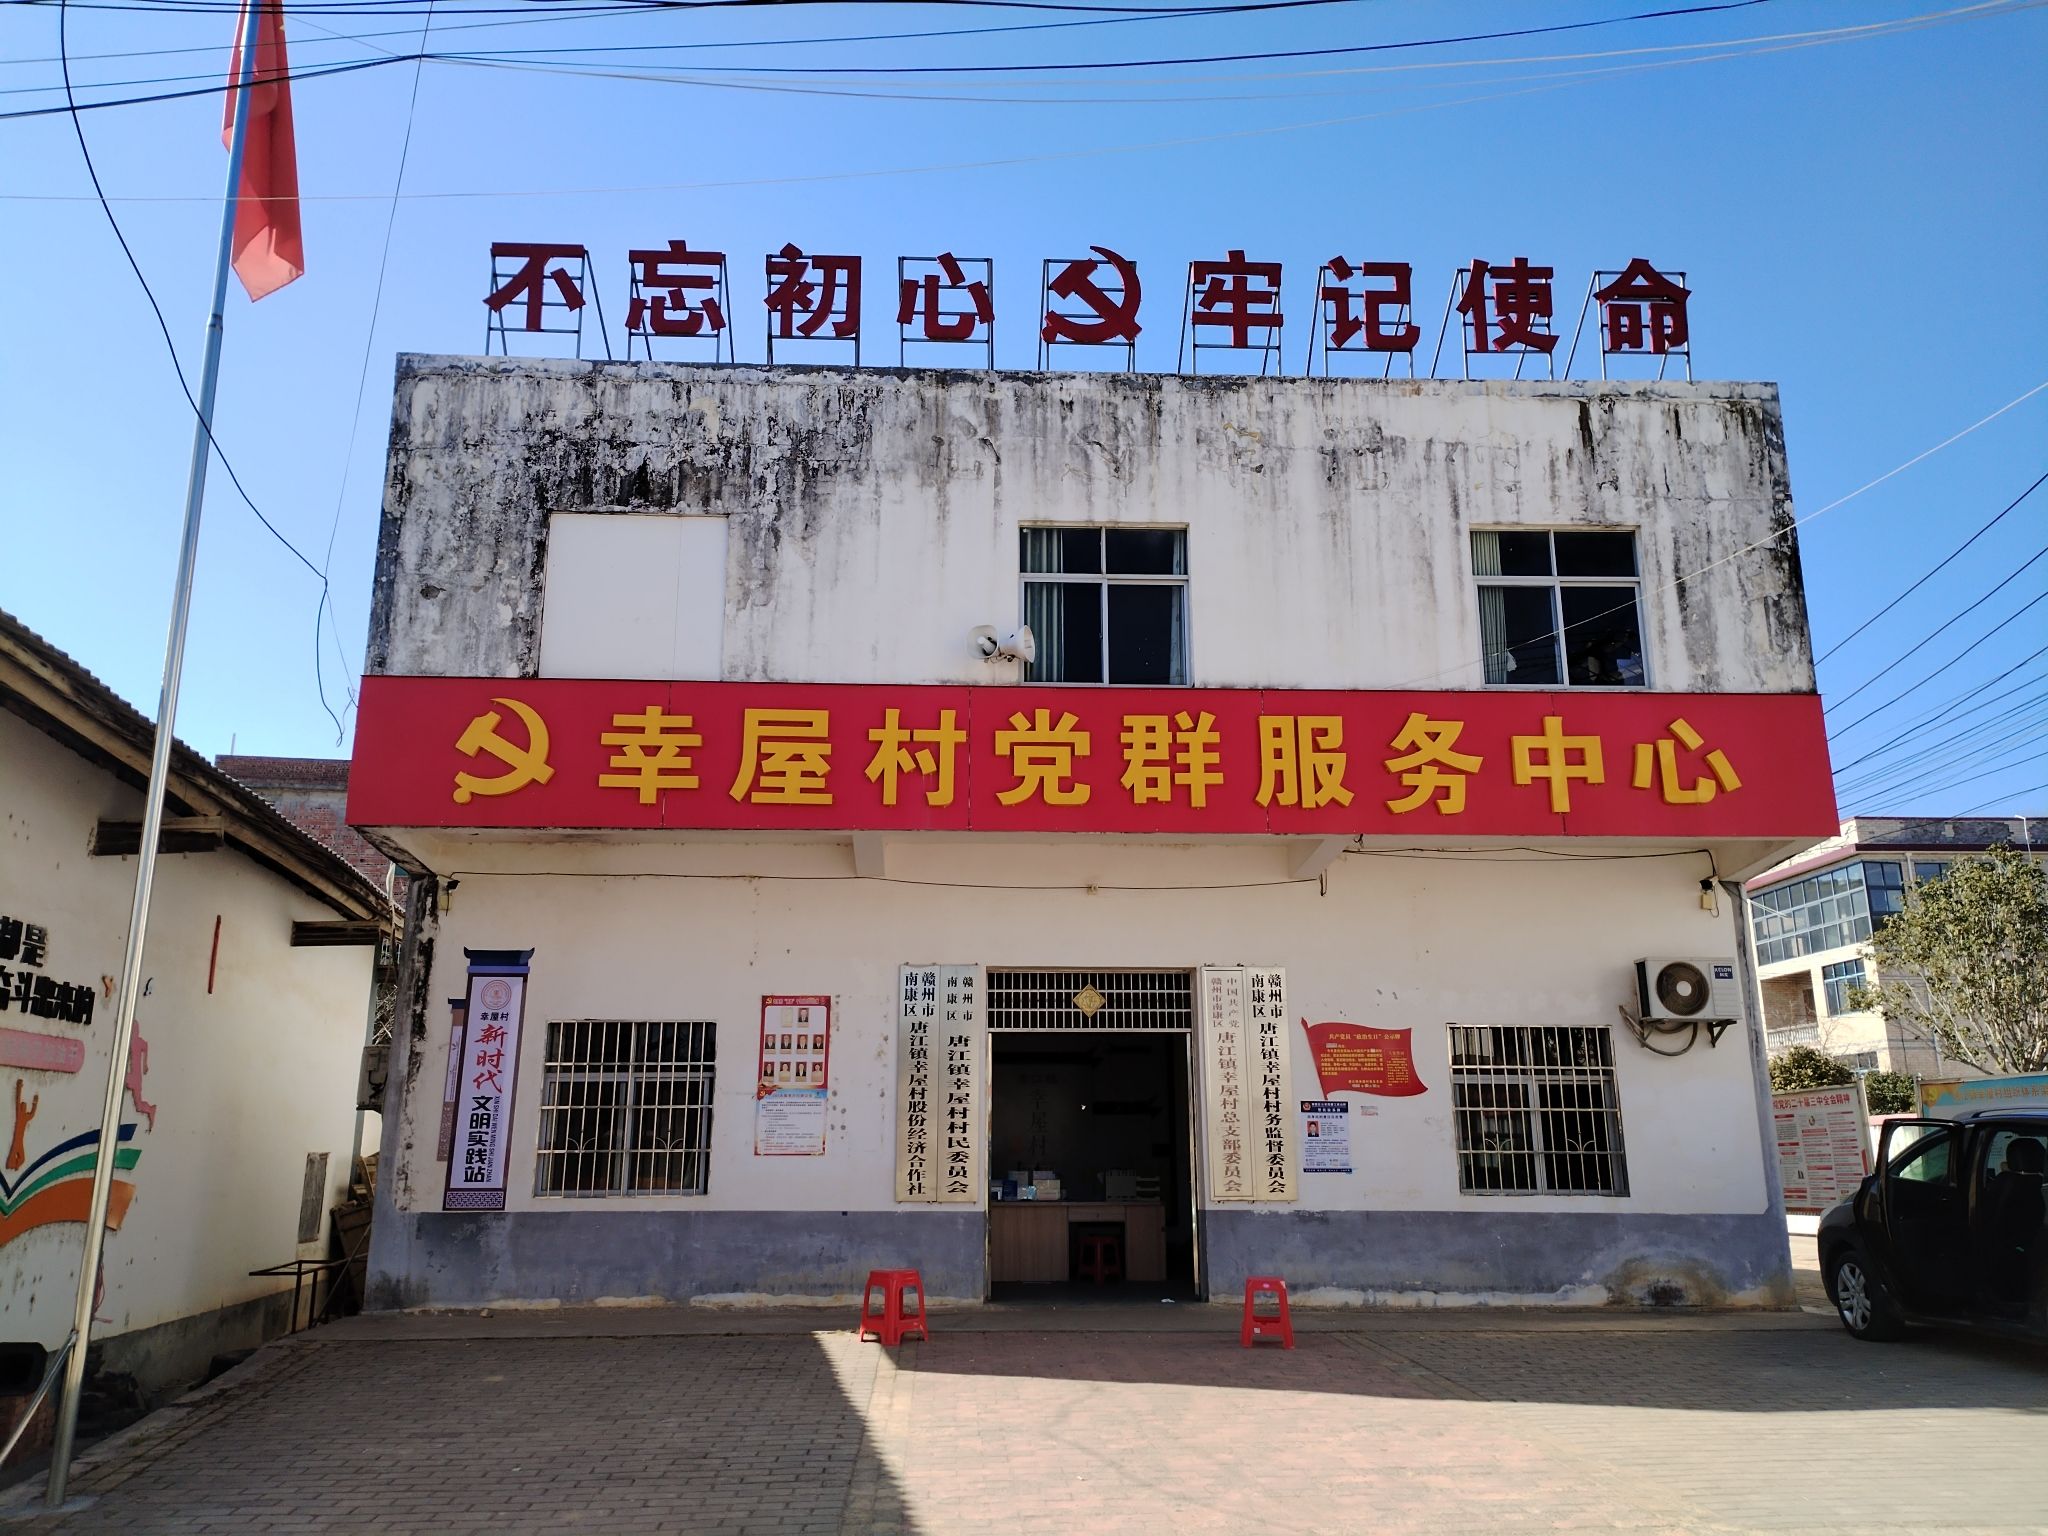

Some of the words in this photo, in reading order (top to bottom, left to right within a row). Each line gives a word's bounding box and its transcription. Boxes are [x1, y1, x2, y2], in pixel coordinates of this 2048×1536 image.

[484, 240, 994, 340] 不忘初心
[1192, 249, 1691, 355] 牢记使命
[599, 705, 1743, 815] 幸屋村党群服务中心
[480, 1012, 509, 1021] 幸屋村
[904, 972, 919, 1016] 南康区
[922, 972, 936, 1017] 赣州市
[946, 976, 958, 1020] 南康区
[962, 976, 974, 1021] 赣州市
[1212, 978, 1223, 1027] 赣州市南康区
[1227, 978, 1240, 1027] 中国共产党
[1251, 973, 1266, 1018] 南康区
[1268, 973, 1283, 1018] 赣州市
[473, 1024, 508, 1093] 新时代
[907, 1021, 929, 1195] 唐江镇幸屋村股份经济合作社
[946, 1035, 971, 1193] 唐江镇幸屋村村民委员会
[1217, 1032, 1243, 1192] 唐江镇幸屋村总支部委员会
[1259, 1022, 1286, 1193] 唐江镇幸屋村村务监督委员会
[464, 1096, 493, 1183] 文明实践站
